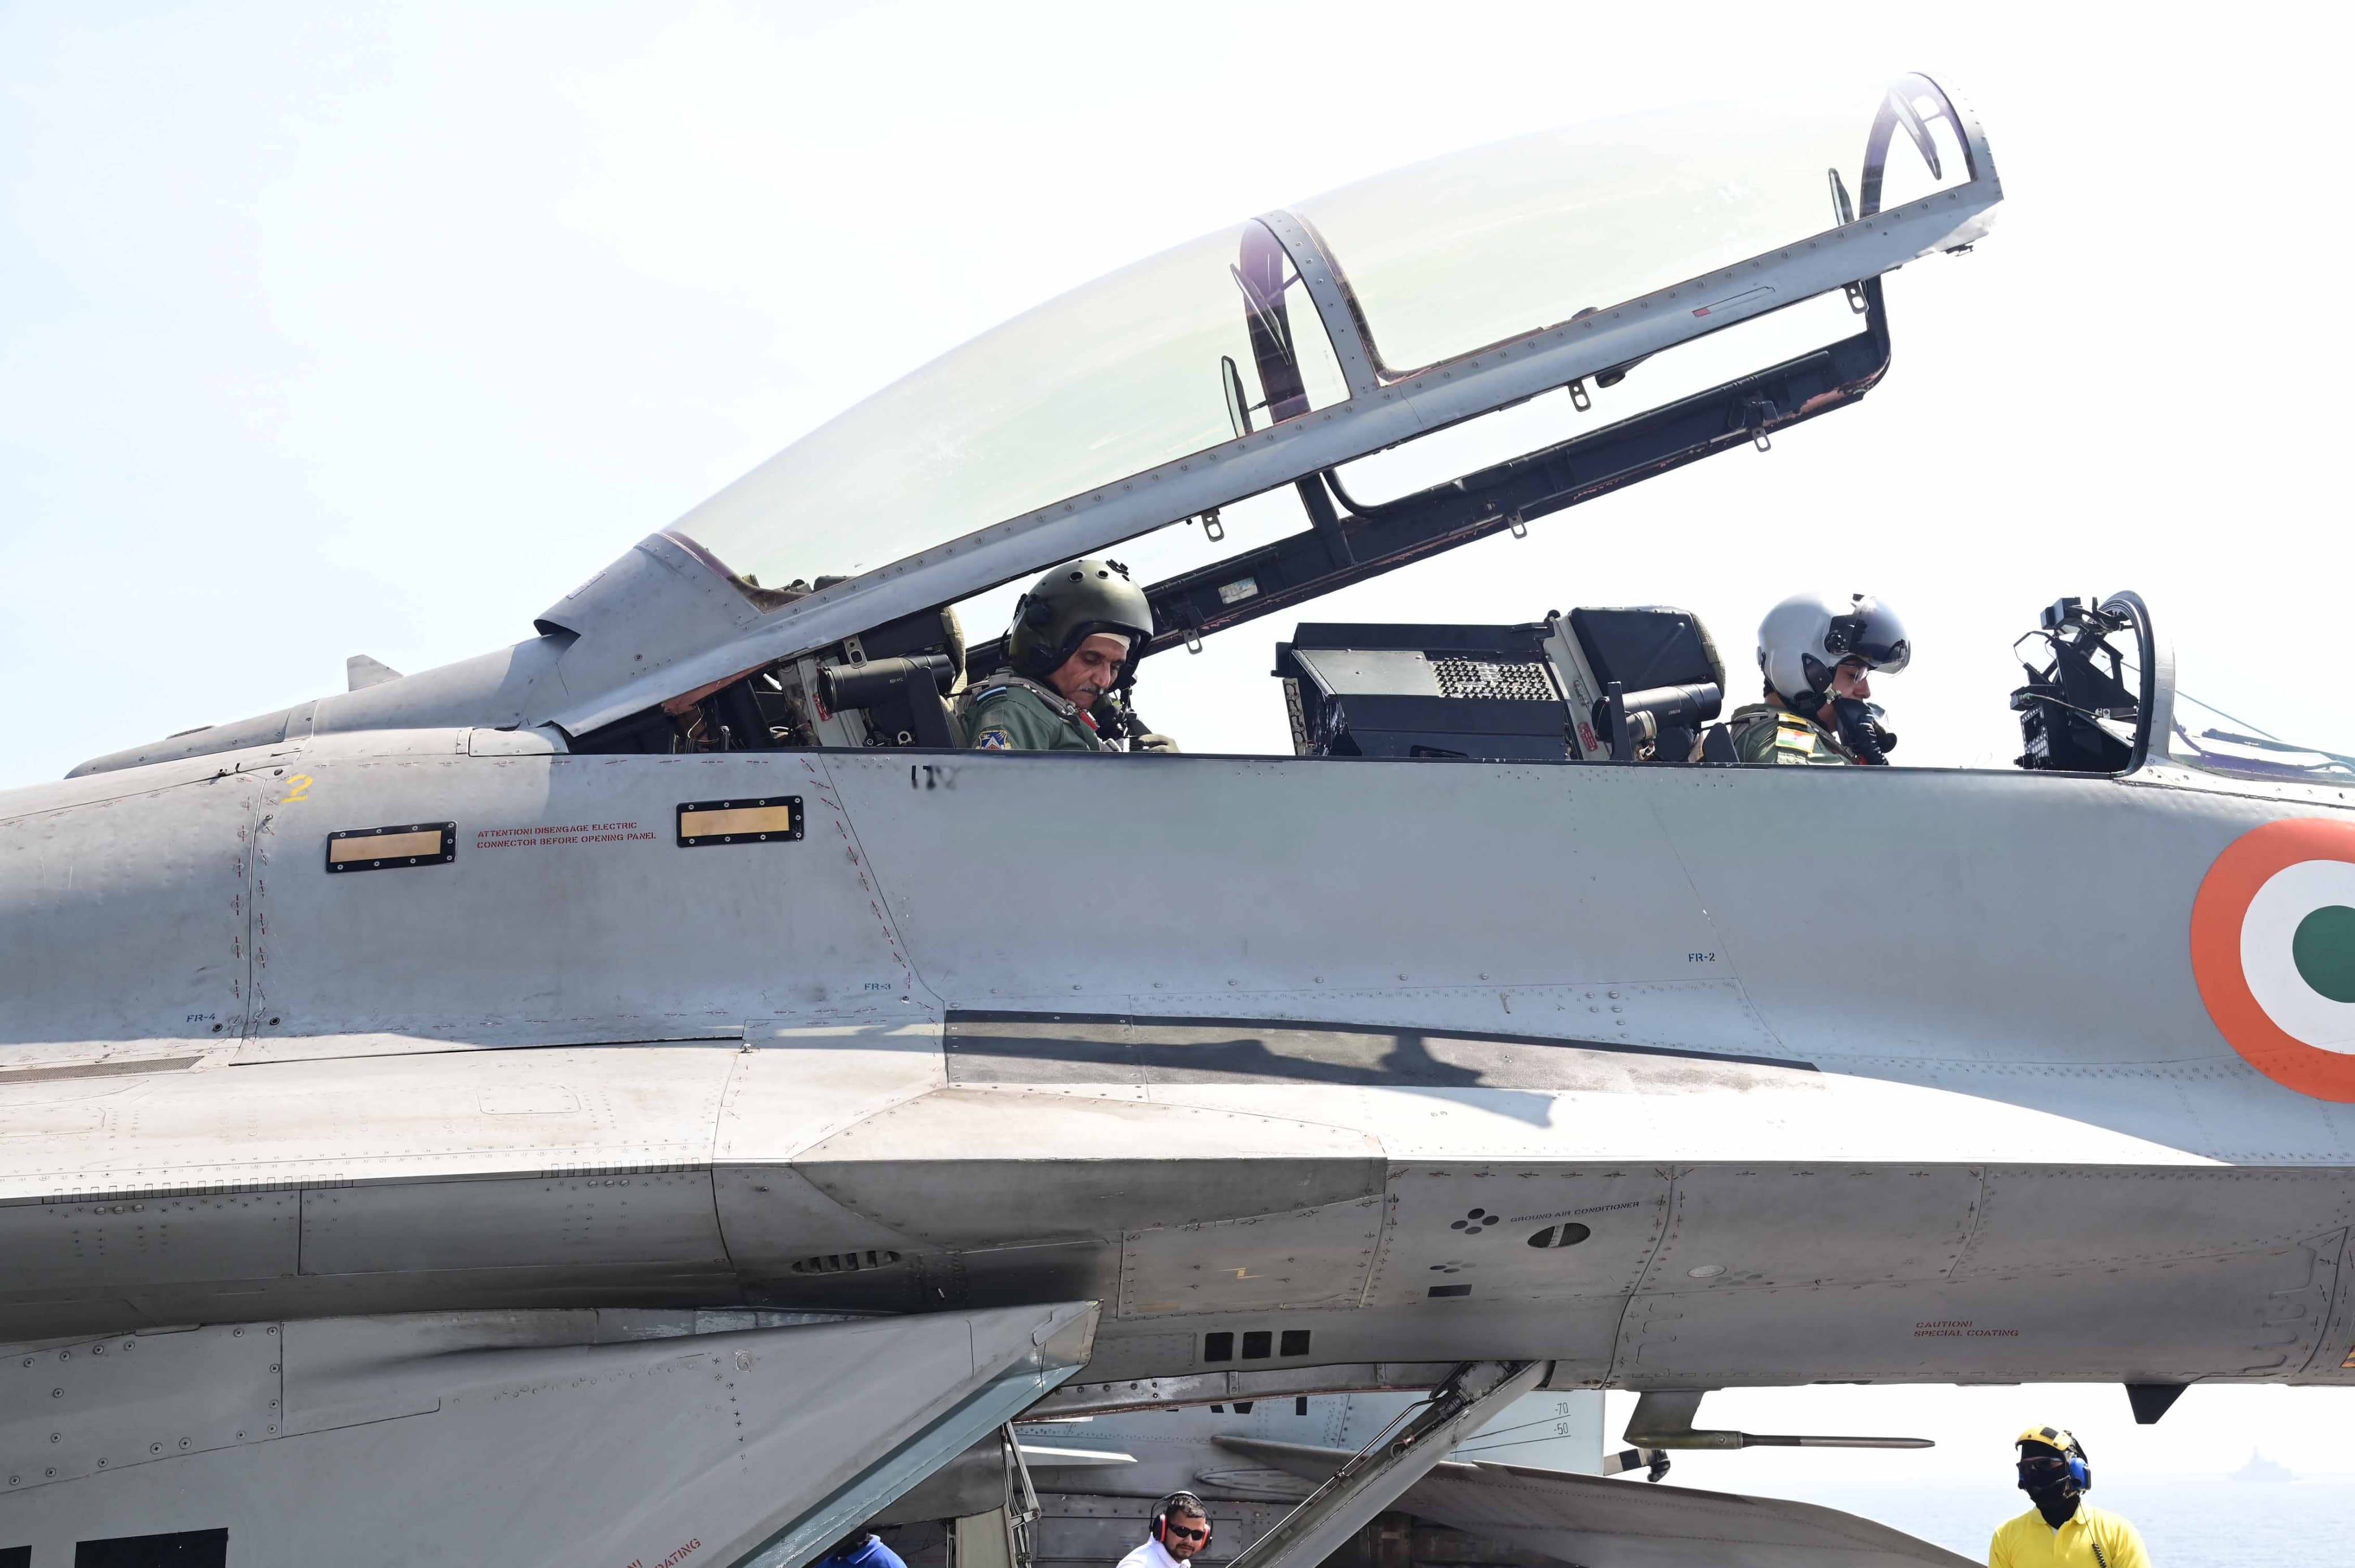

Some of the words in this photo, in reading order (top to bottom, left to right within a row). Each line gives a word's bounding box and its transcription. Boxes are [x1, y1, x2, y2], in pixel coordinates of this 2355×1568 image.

[281, 774, 314, 803] 2
[478, 828, 532, 838] ATTENTION!
[535, 824, 589, 835] DISENGAGE
[592, 822, 637, 832] ELECTRIC
[477, 838, 537, 849] CONNECTOR
[540, 836, 578, 845] BEFORE
[581, 834, 624, 843] OPENING
[1689, 952, 1715, 962] FR-2
[186, 1013, 216, 1023] FR-4
[1510, 1213, 1552, 1223] GROUND
[1574, 1201, 1640, 1215] CONDITIONER
[1555, 1402, 1569, 1415] -70
[1553, 1422, 1569, 1434] -50
